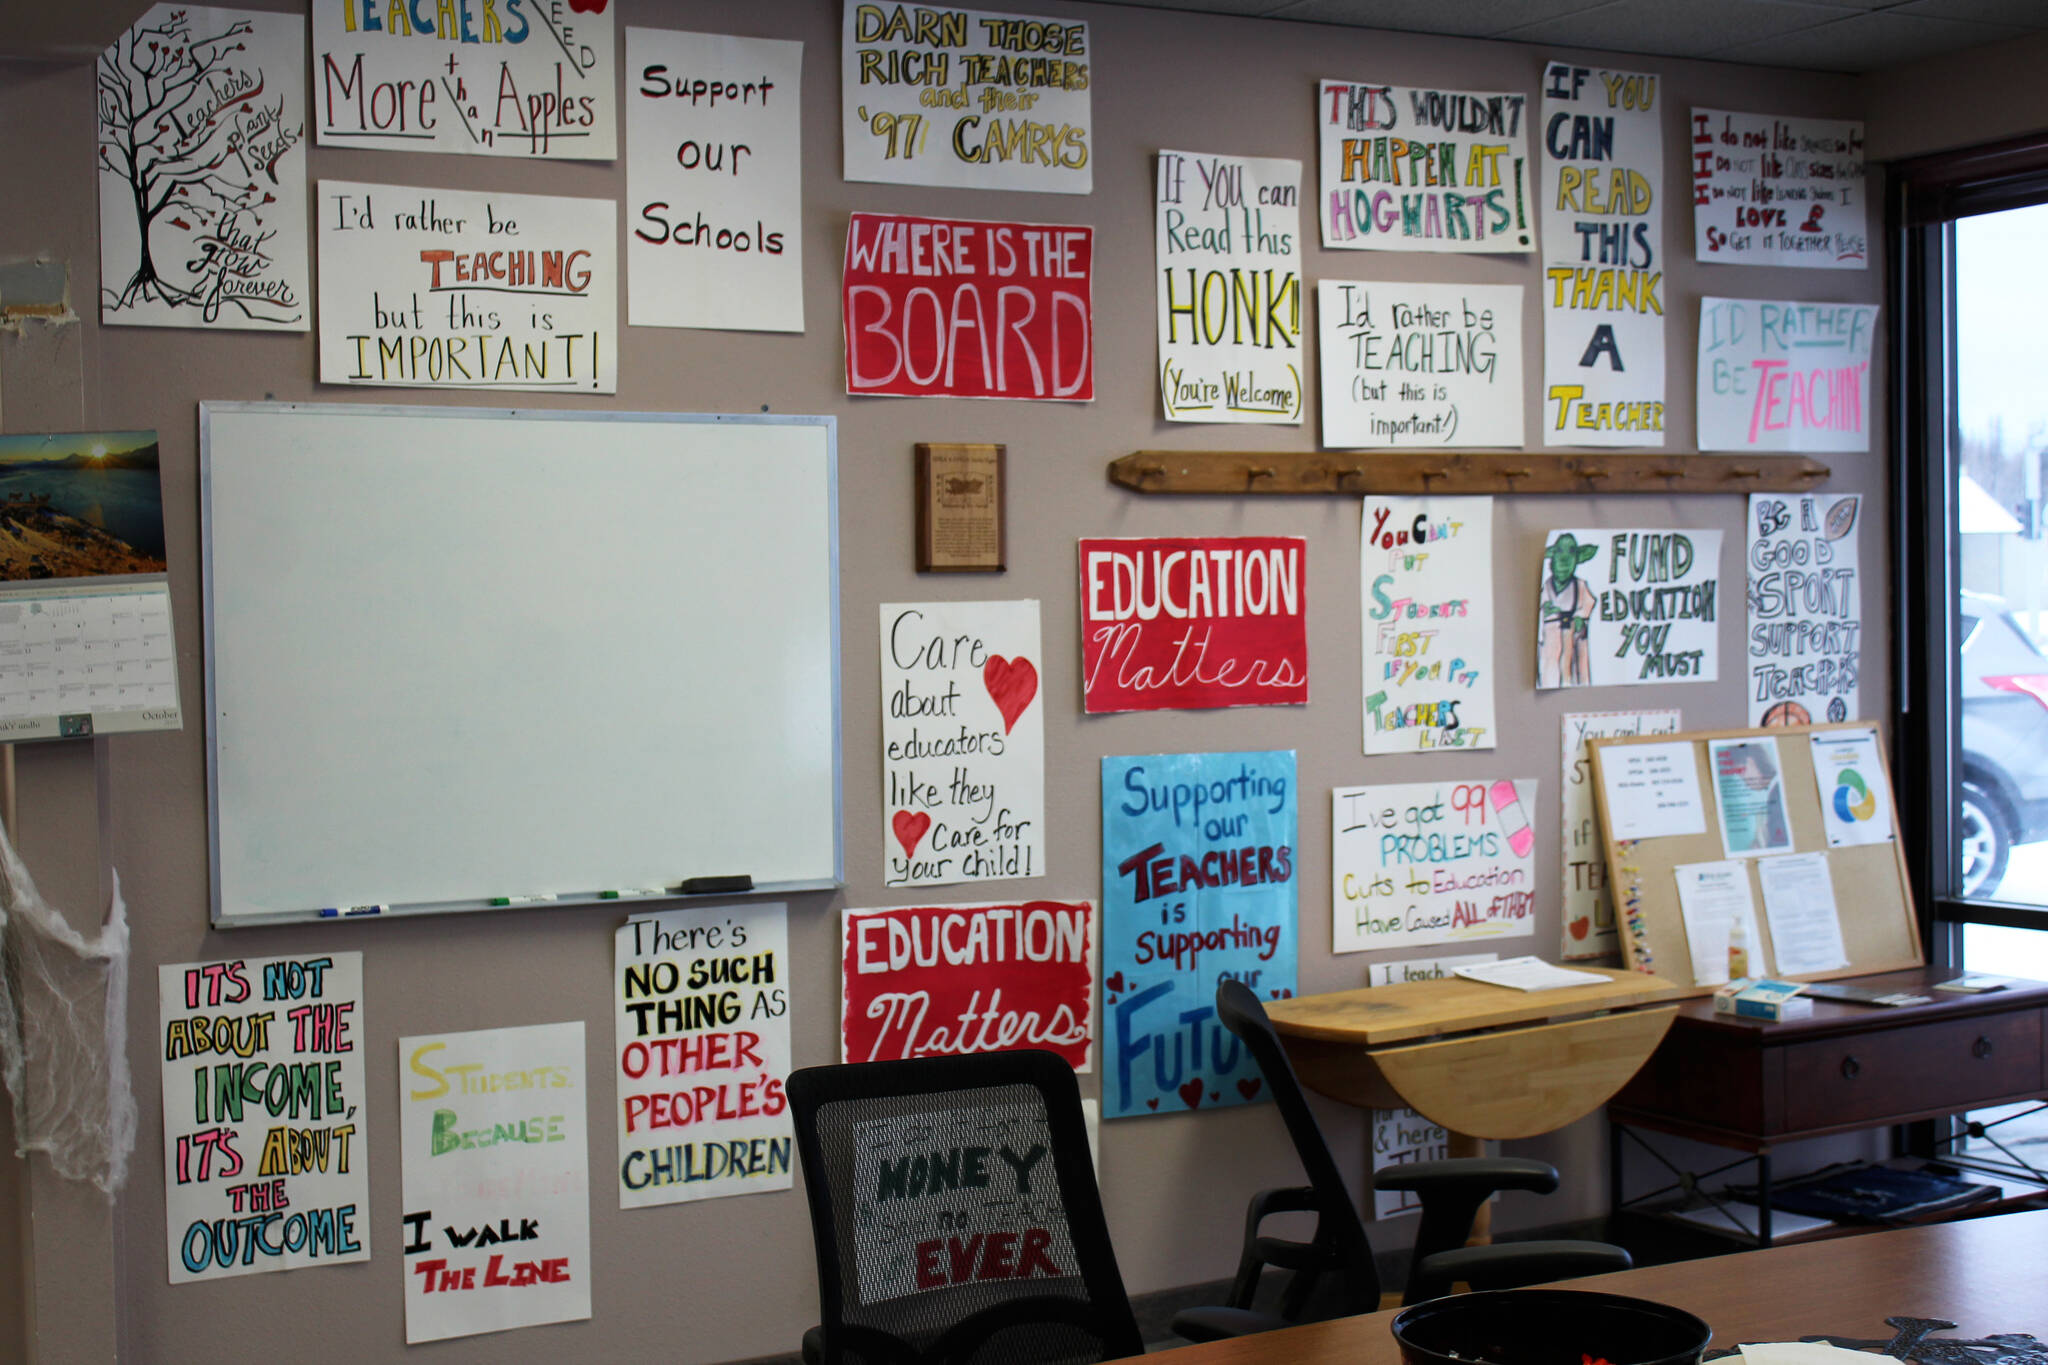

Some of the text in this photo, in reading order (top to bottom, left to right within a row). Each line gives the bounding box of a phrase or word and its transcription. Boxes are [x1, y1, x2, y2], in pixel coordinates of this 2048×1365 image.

[856, 4, 1085, 56] DARN THOSE
[639, 64, 775, 108] Support
[857, 49, 1089, 92] RICH TEACHERS
[1545, 65, 1655, 112] IF YOU
[321, 52, 437, 131] More
[494, 61, 596, 154] Apples
[919, 81, 1040, 114] and their
[1324, 85, 1397, 132] THIS
[676, 139, 752, 176] our
[952, 115, 1089, 169] CAMRYS
[1546, 112, 1615, 162] CAN
[1341, 137, 1509, 188] HAPPEN AT
[1258, 183, 1297, 207] can
[1329, 157, 1531, 247] HOGWARTS!
[1556, 166, 1652, 216] READ
[331, 195, 520, 237] I'd rather be
[633, 201, 785, 256] Schools
[1165, 206, 1293, 256] Read this
[1735, 205, 1787, 228] LOVE
[849, 218, 1087, 280] WHERE IS THE
[1573, 220, 1653, 270] THIS
[420, 249, 592, 293] TEACHING
[1546, 266, 1664, 316] THANK
[374, 291, 554, 331] but this is
[1336, 284, 1494, 331] I'd rather be
[346, 331, 600, 389] IMPORTANT!
[848, 283, 1088, 397] BOARD
[1349, 331, 1497, 384] TEACHING
[1578, 324, 1625, 372] A
[1351, 374, 1448, 402] (but this is
[1712, 358, 1748, 396] BE
[1549, 385, 1664, 432] TEACHER
[1608, 531, 1695, 584] FUND
[1751, 538, 1834, 572] GOOD
[1086, 547, 1299, 621] EDUCATION
[1600, 578, 1716, 623] EDUCATION
[1756, 567, 1855, 619] SPORT
[890, 608, 989, 671] Care
[1083, 621, 1307, 694] Matters
[1615, 623, 1672, 658] YOU
[1750, 619, 1861, 658] SUPPORT
[1638, 648, 1704, 681] MUST
[890, 679, 962, 720] about
[887, 729, 1006, 762] educators
[890, 766, 995, 825] like they
[1121, 763, 1287, 827] Supporting
[1451, 784, 1486, 826] 99
[930, 808, 1031, 854] Care for
[1204, 812, 1249, 842] our
[1380, 832, 1500, 868] PROBLEMS
[887, 843, 1032, 887] your child!
[1119, 842, 1293, 904] TEACHERS
[1343, 865, 1525, 901] Cuts to Education
[628, 917, 748, 957] There's
[1161, 900, 1187, 926] is
[1355, 904, 1402, 936] Have
[1451, 900, 1487, 929] ALL
[856, 909, 1087, 974] EDUCATION
[262, 956, 334, 1002] NOT
[624, 951, 776, 999] NO SUCH
[1383, 962, 1445, 985] I teach
[166, 1000, 356, 1061] ABOUT THE
[625, 988, 787, 1037] THING AS
[866, 988, 1088, 1062] Matters
[621, 1031, 765, 1080] OTHER
[194, 1059, 358, 1125] INCOME,
[623, 1071, 788, 1134] PEOPLE'S
[257, 1122, 356, 1177] ABOUT
[431, 1107, 567, 1158] BECAUSE
[1396, 1122, 1445, 1147] here
[621, 1136, 793, 1191] CHILDREN
[877, 1143, 1049, 1203] MONEY
[226, 1178, 290, 1214] THE
[181, 1203, 362, 1274] OUTCOME
[402, 1210, 539, 1256] I WALK
[413, 1253, 571, 1294] THE LINE
[916, 1227, 1062, 1290] EVER
